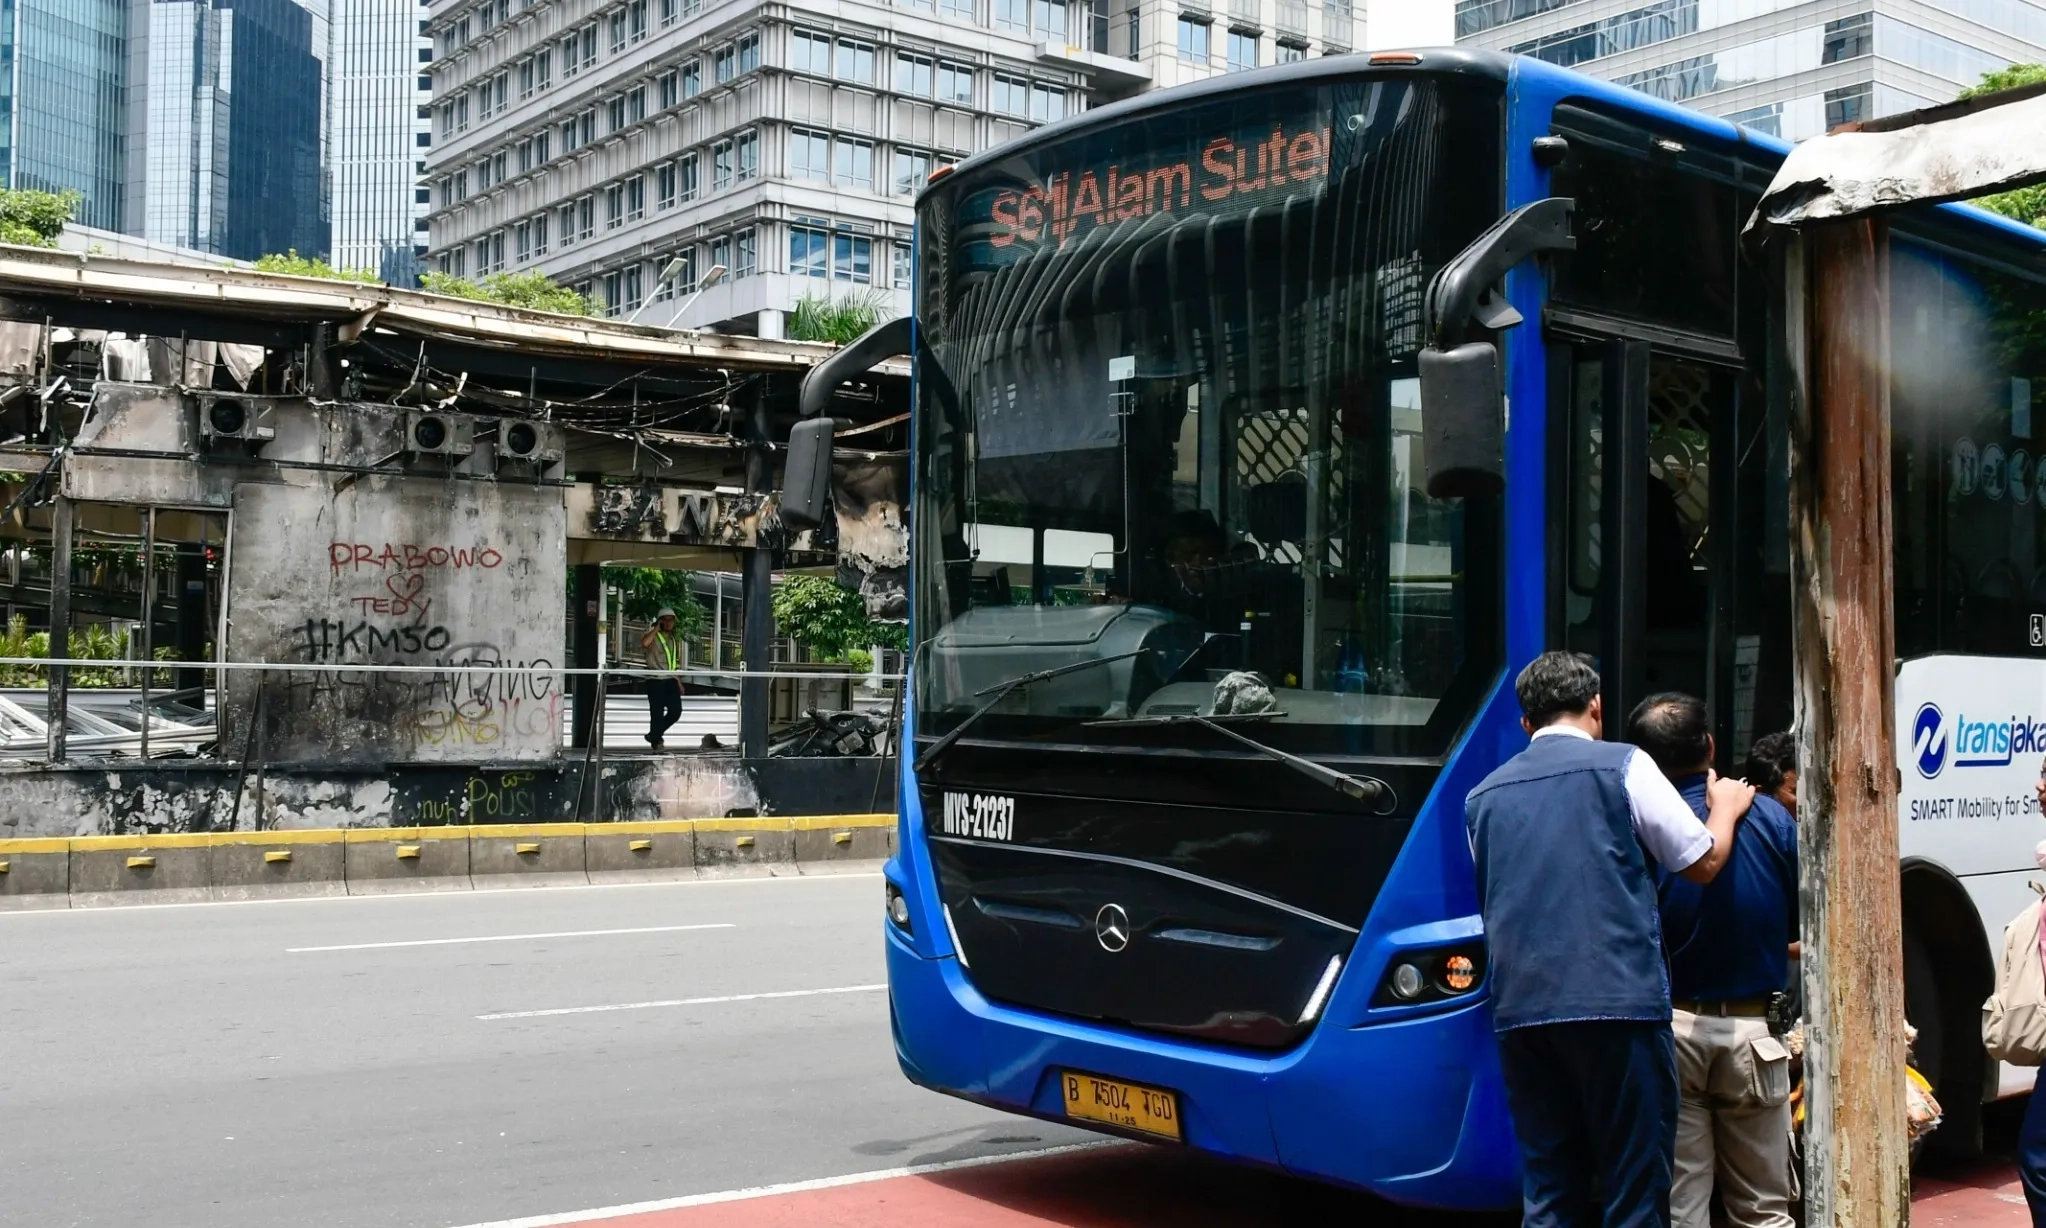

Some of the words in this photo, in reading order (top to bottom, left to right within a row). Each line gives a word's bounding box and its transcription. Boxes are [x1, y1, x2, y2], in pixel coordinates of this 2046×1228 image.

[593, 486, 752, 542] BANK
[327, 542, 503, 577] PRABOWO
[351, 597, 432, 627] TEDY
[292, 618, 450, 662] #KM50
[943, 791, 1015, 841] MYS-21237
[1910, 798, 1955, 821] SMART
[1957, 797, 2003, 821] Mobility
[2005, 795, 2021, 816] for
[1067, 1077, 1080, 1102] B
[1089, 1080, 1130, 1112] 7504
[1141, 1090, 1173, 1120] TGD
